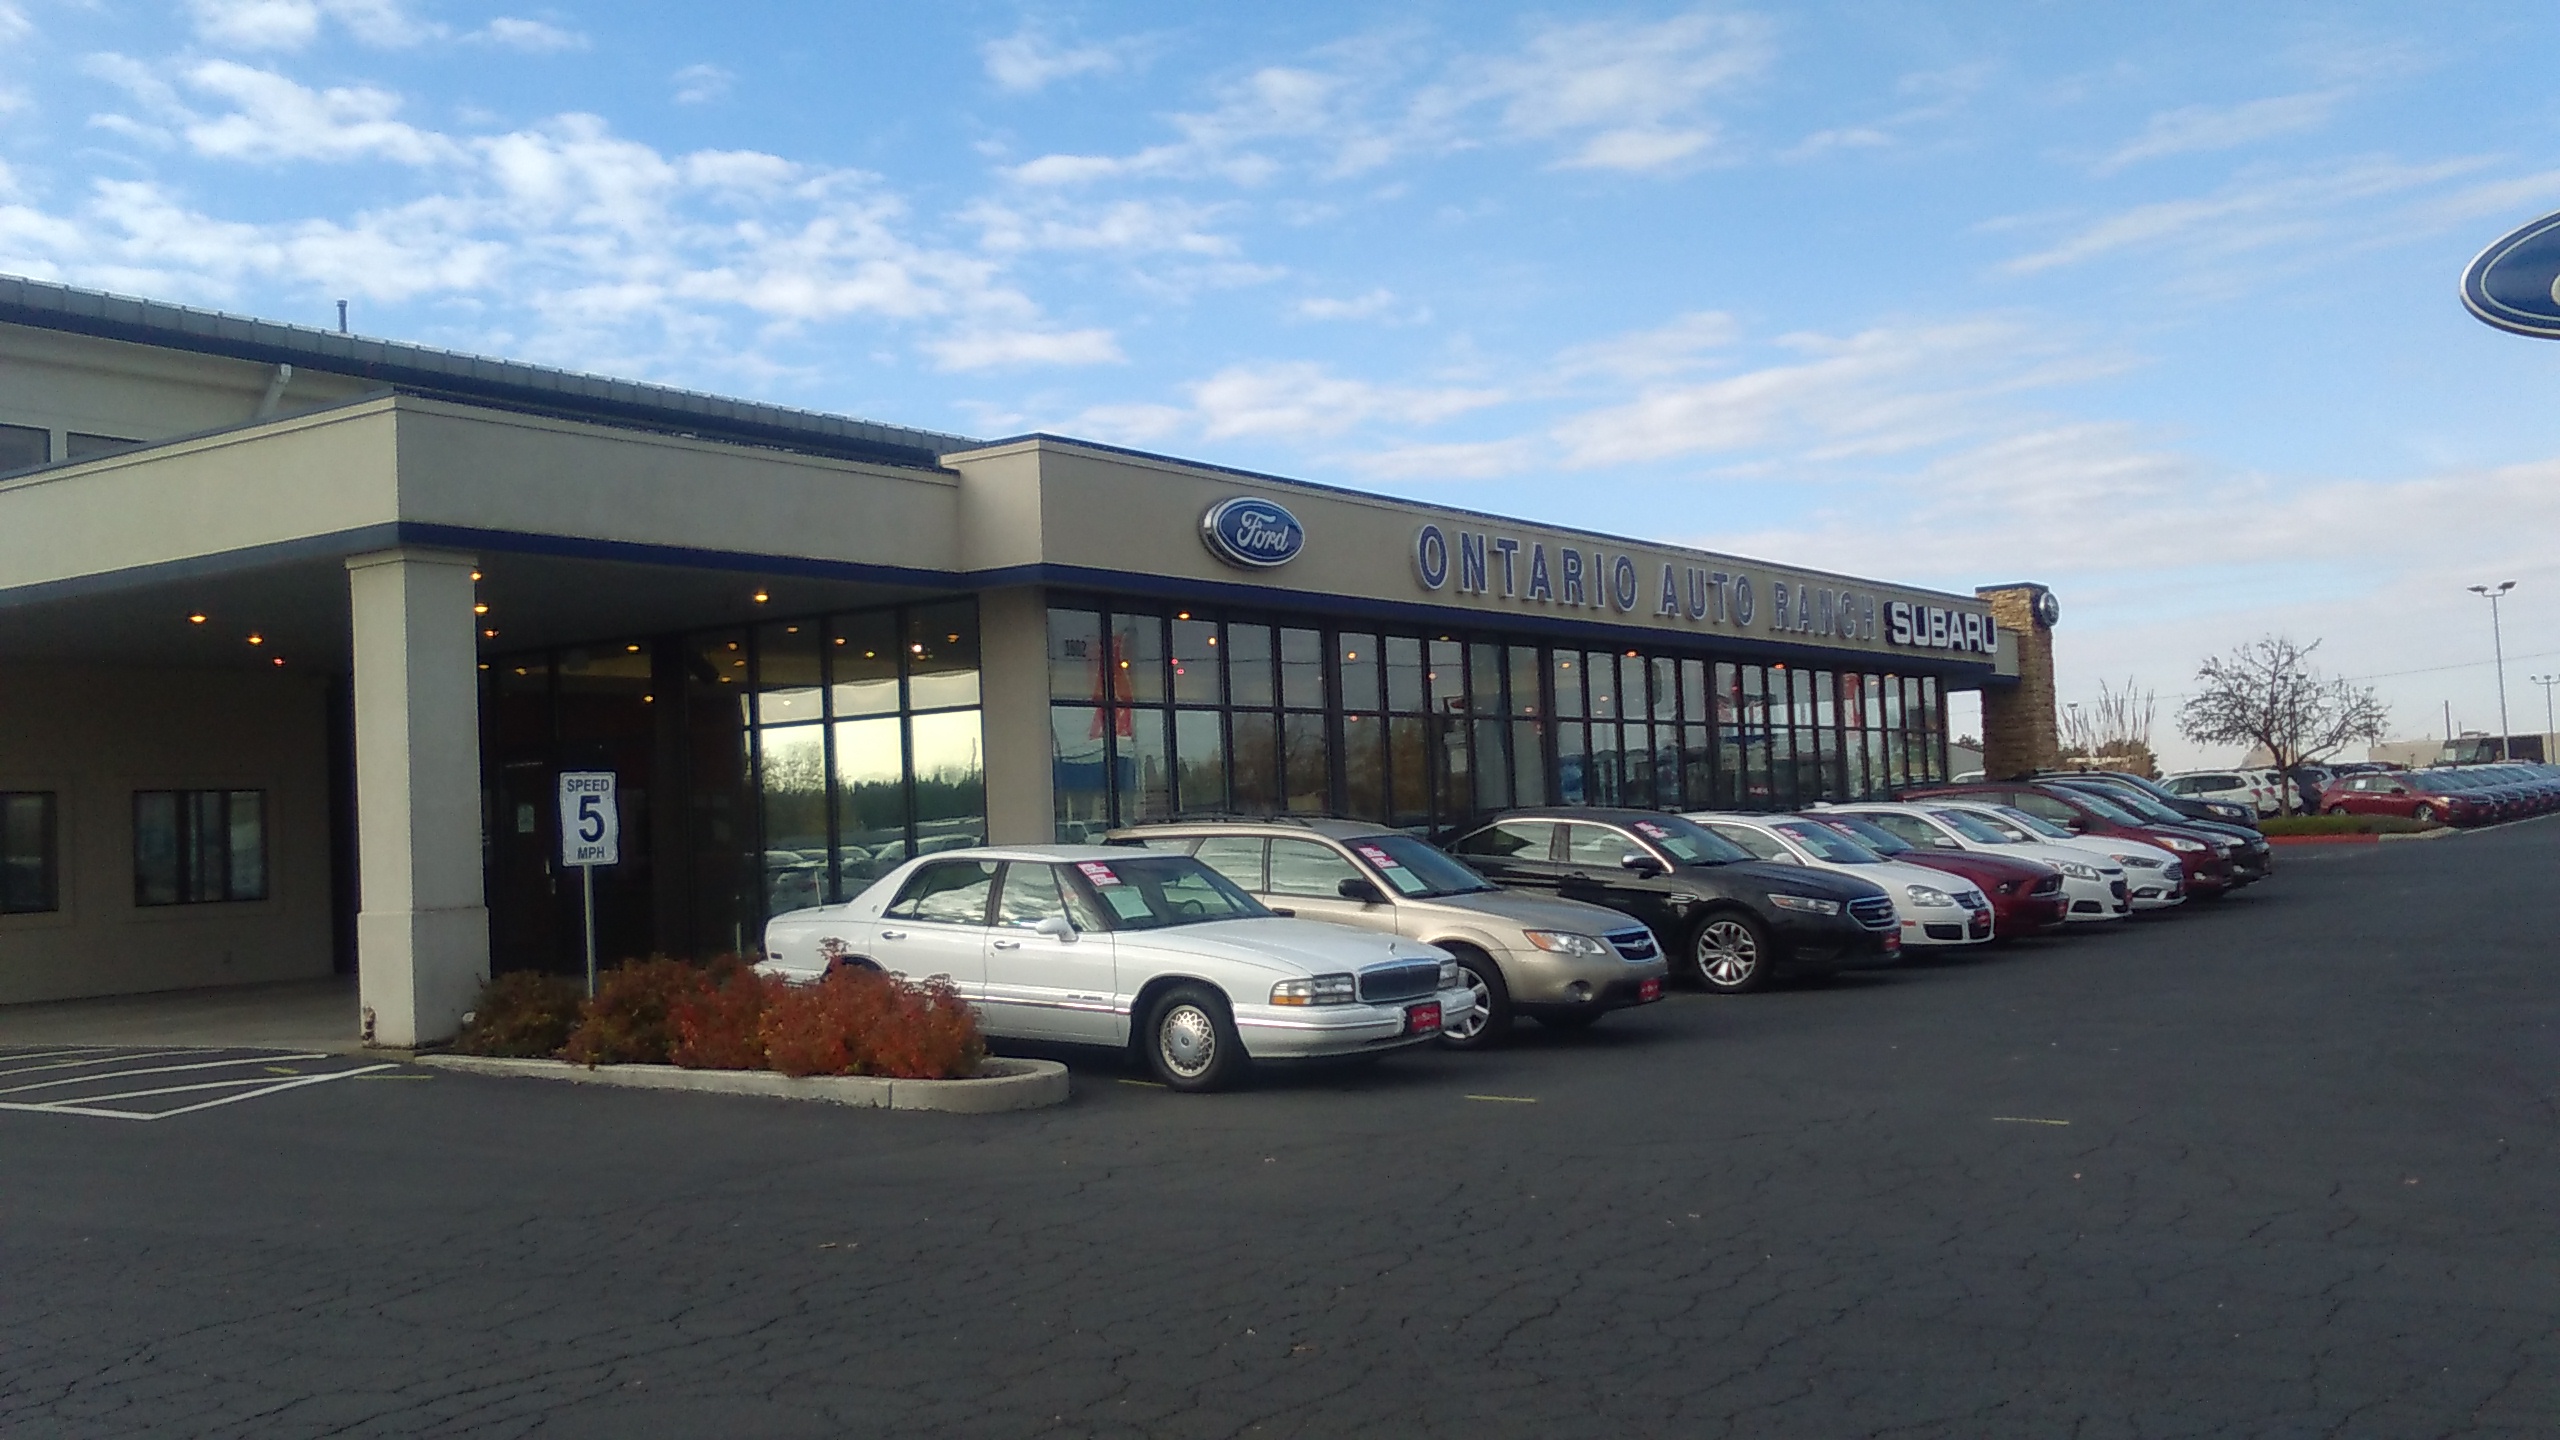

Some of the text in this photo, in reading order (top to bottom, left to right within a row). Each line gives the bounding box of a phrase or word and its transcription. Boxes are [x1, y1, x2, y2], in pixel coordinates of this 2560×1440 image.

[1236, 510, 1289, 552] Ford
[1415, 523, 1878, 641] ONTARIO AUTO RANCH
[1889, 600, 1999, 654] SUBARU
[566, 779, 610, 793] SPEED
[578, 794, 606, 843] 5
[577, 846, 605, 860] MPH
